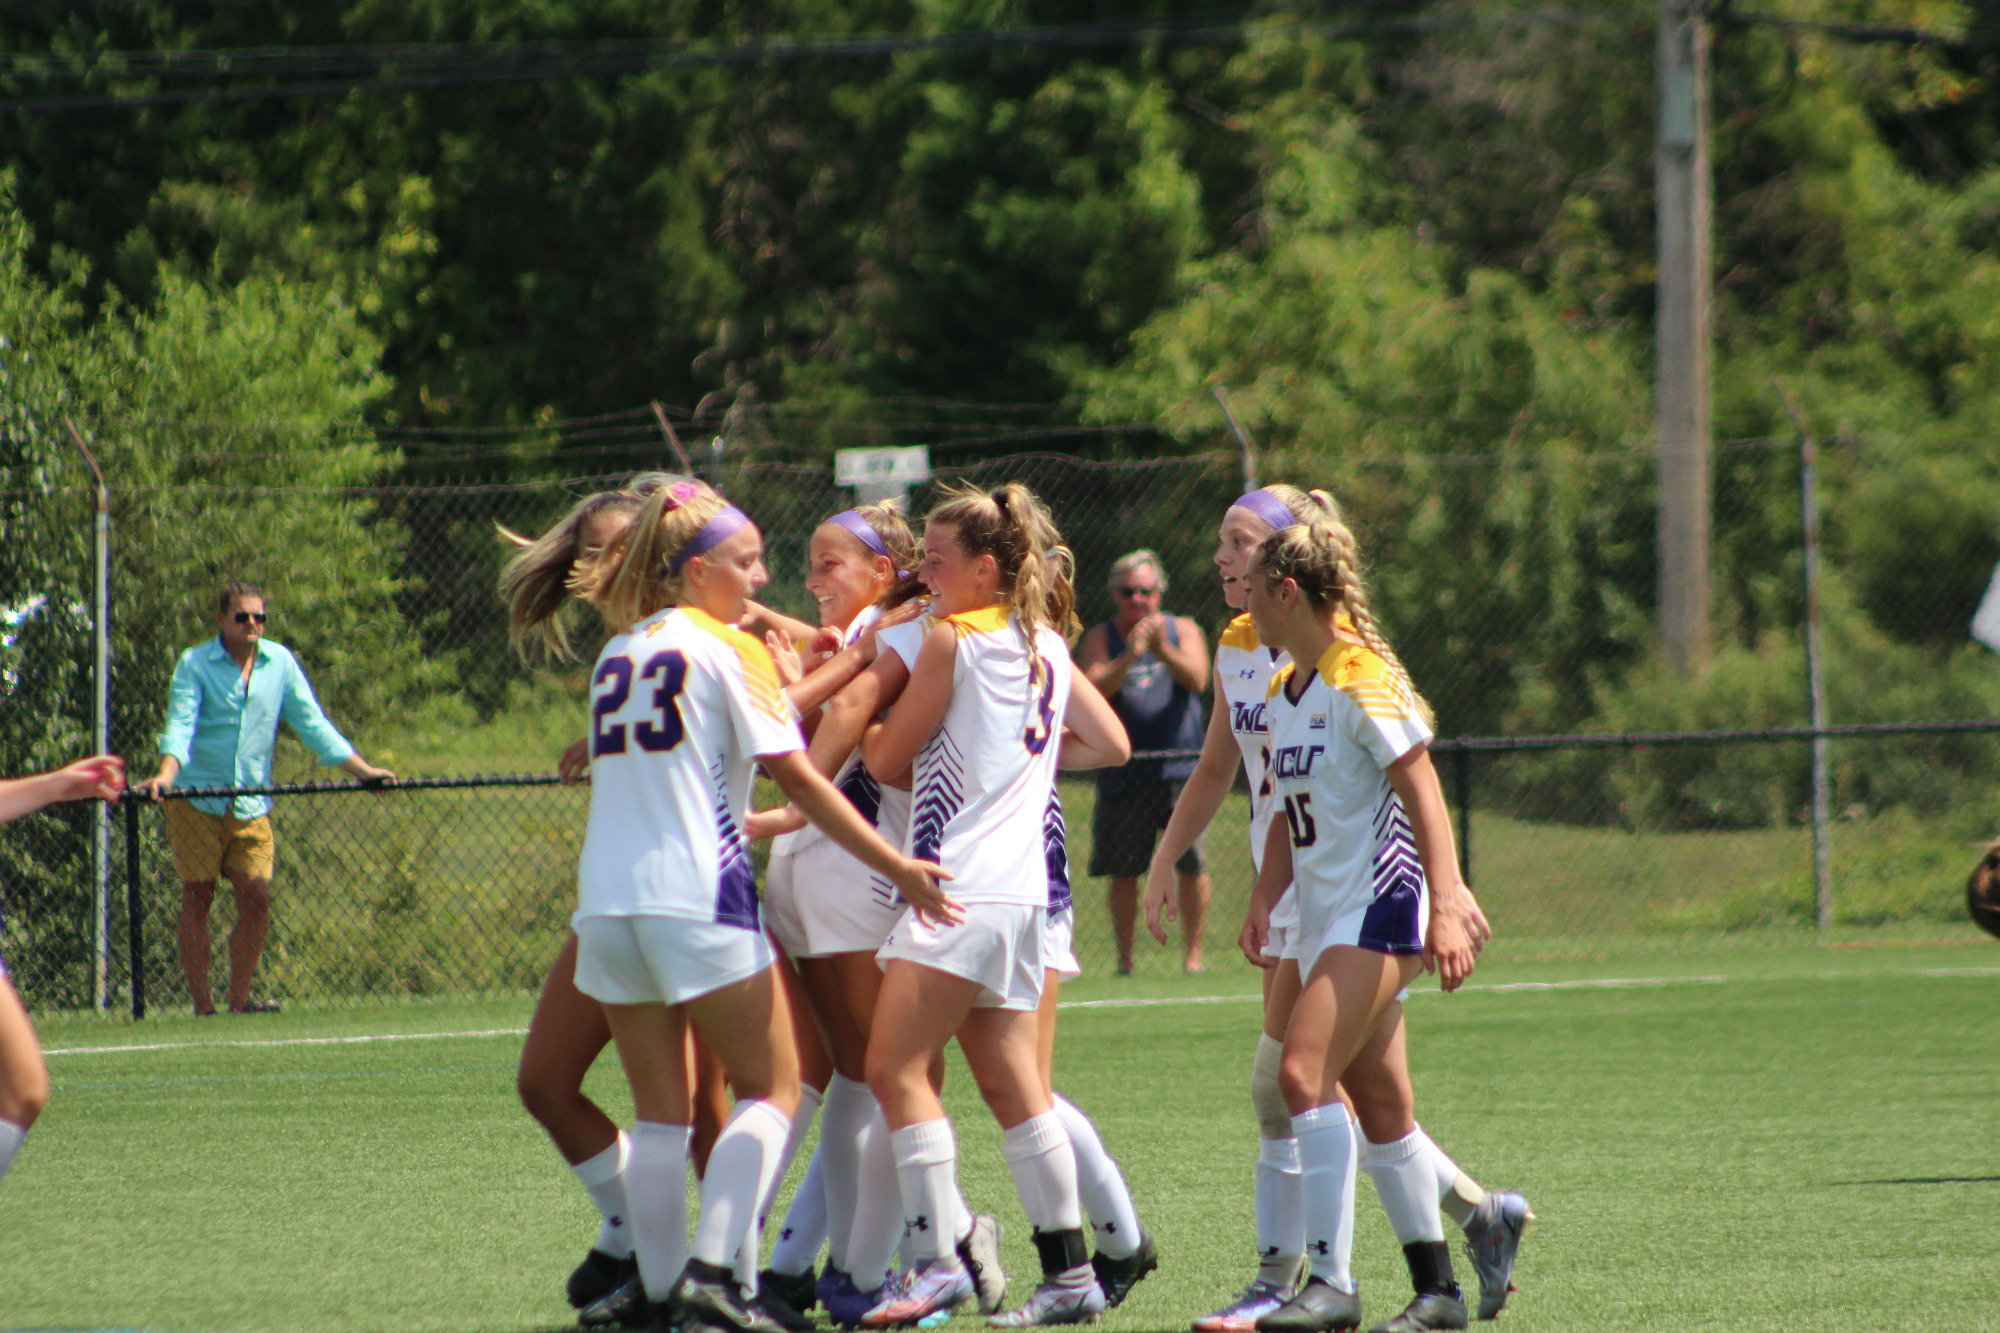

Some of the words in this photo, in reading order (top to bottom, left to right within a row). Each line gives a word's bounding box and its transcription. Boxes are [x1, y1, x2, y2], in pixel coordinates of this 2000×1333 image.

[593, 649, 688, 759] 23
[1025, 655, 1055, 756] 3
[1231, 701, 1268, 735] WC
[1273, 745, 1325, 780] CU
